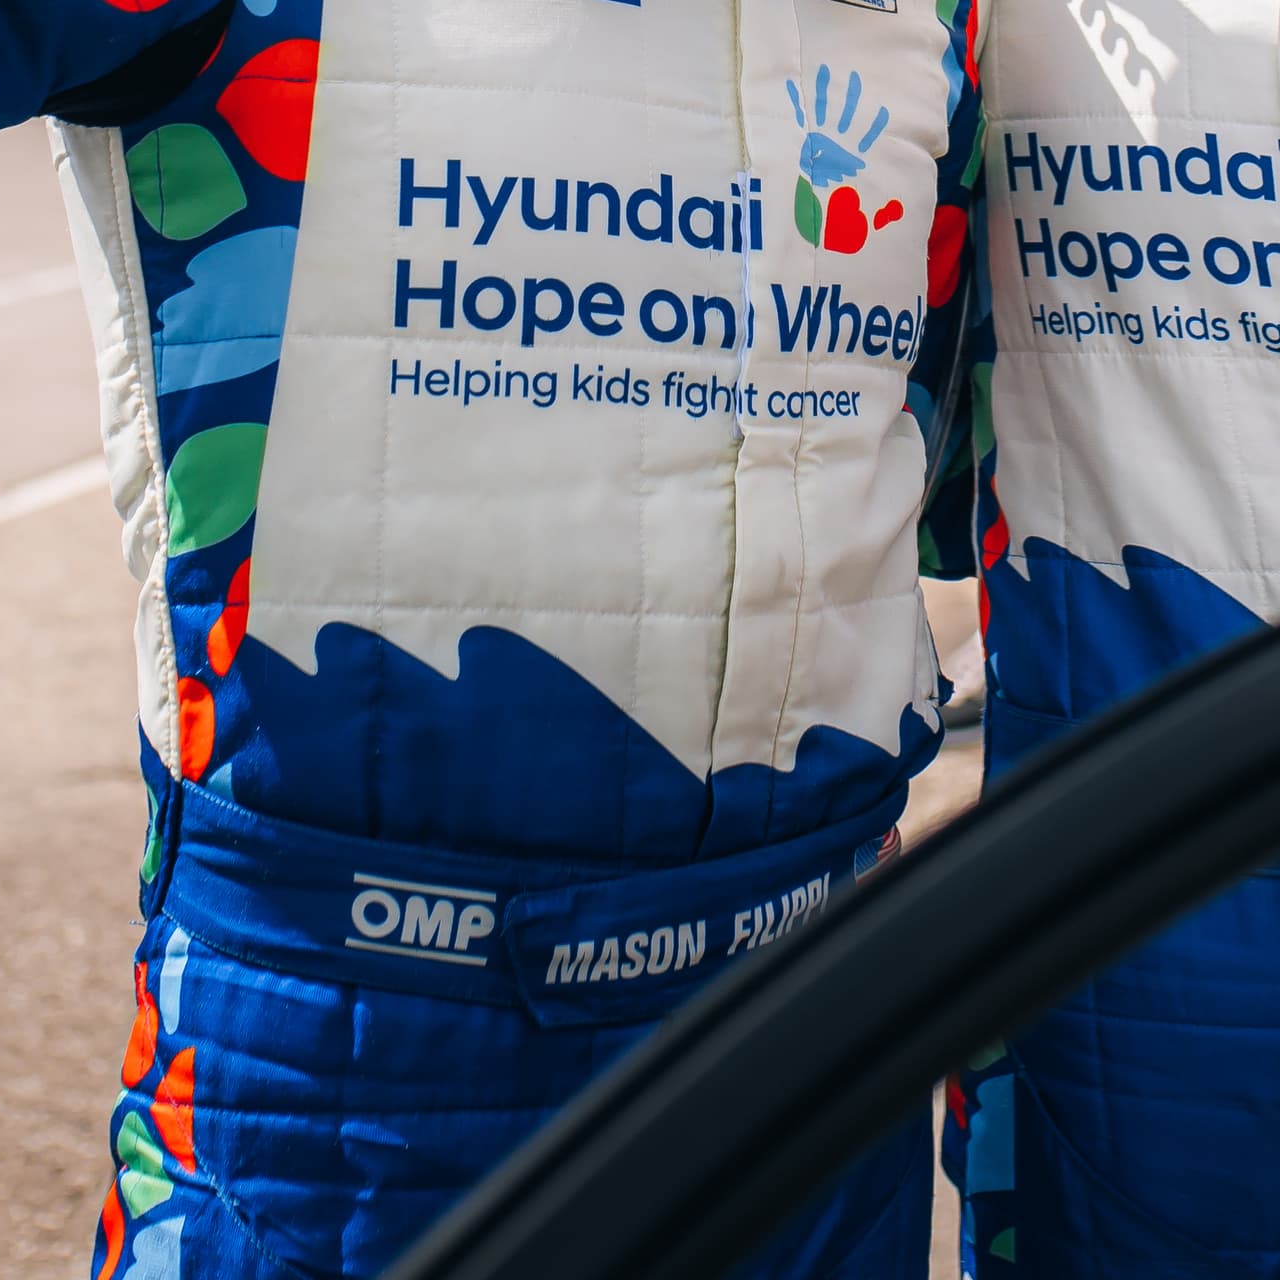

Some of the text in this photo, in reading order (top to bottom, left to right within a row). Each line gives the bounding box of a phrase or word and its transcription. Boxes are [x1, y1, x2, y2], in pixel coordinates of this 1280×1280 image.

[1015, 216, 1190, 293] Hope
[393, 259, 926, 362] Hope on Wheel
[1031, 303, 1144, 344] Helping
[1152, 305, 1231, 342] kids
[390, 360, 861, 419] Helping kids fight cancer
[351, 890, 496, 951] OMP
[545, 871, 831, 985] MASON FILIPPI
